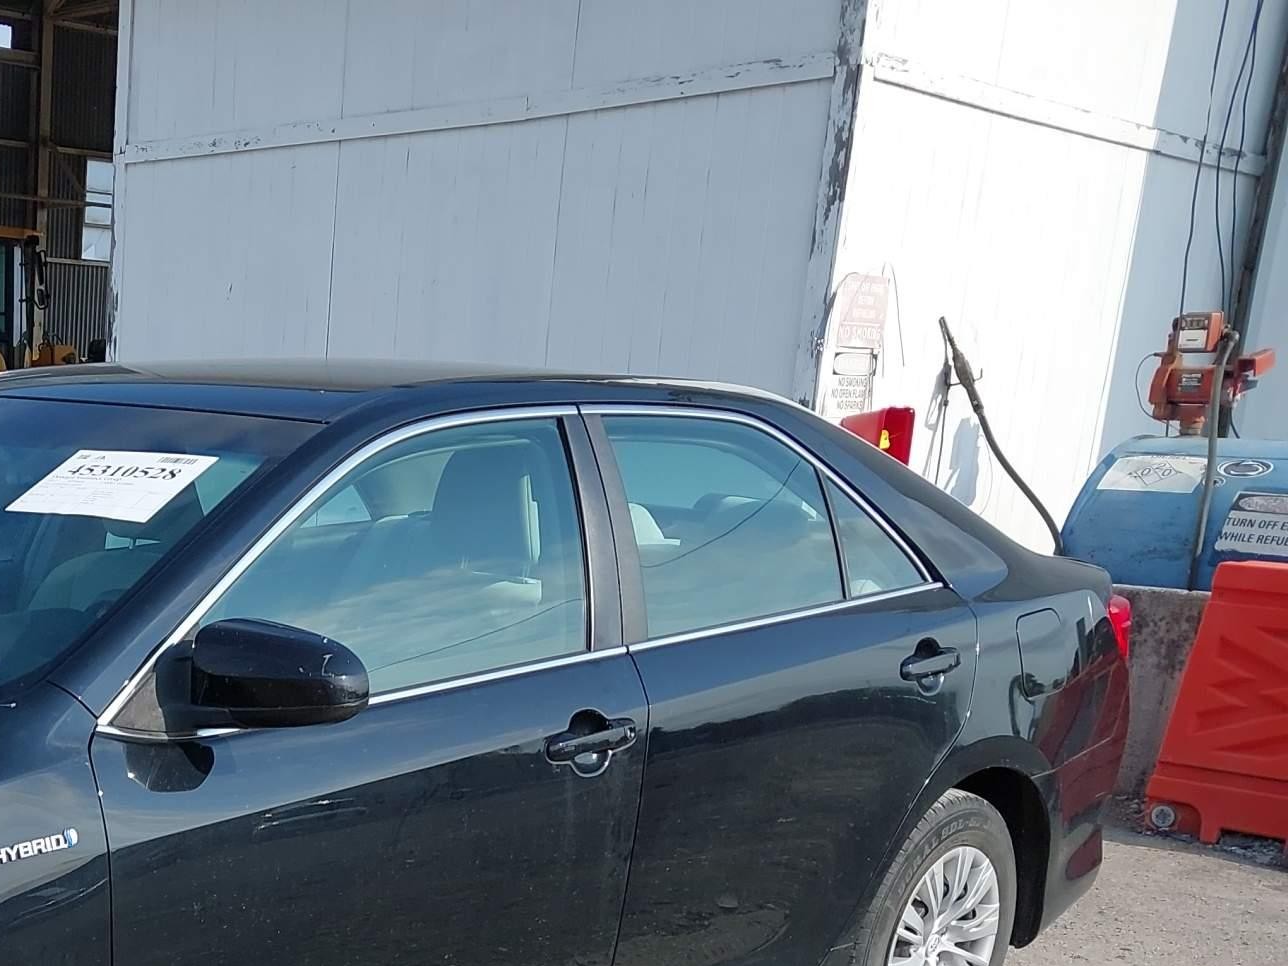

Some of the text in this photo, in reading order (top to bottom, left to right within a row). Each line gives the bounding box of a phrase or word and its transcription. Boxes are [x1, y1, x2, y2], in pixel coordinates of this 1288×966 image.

[838, 325, 850, 338] NO
[838, 377, 868, 388] NO SMOKING
[832, 388, 838, 399] NO
[839, 388, 851, 399] OPEN
[68, 463, 182, 481] 45310528
[1226, 517, 1256, 528] TURN
[1258, 519, 1280, 530] OFF
[1220, 531, 1256, 543] WHILE
